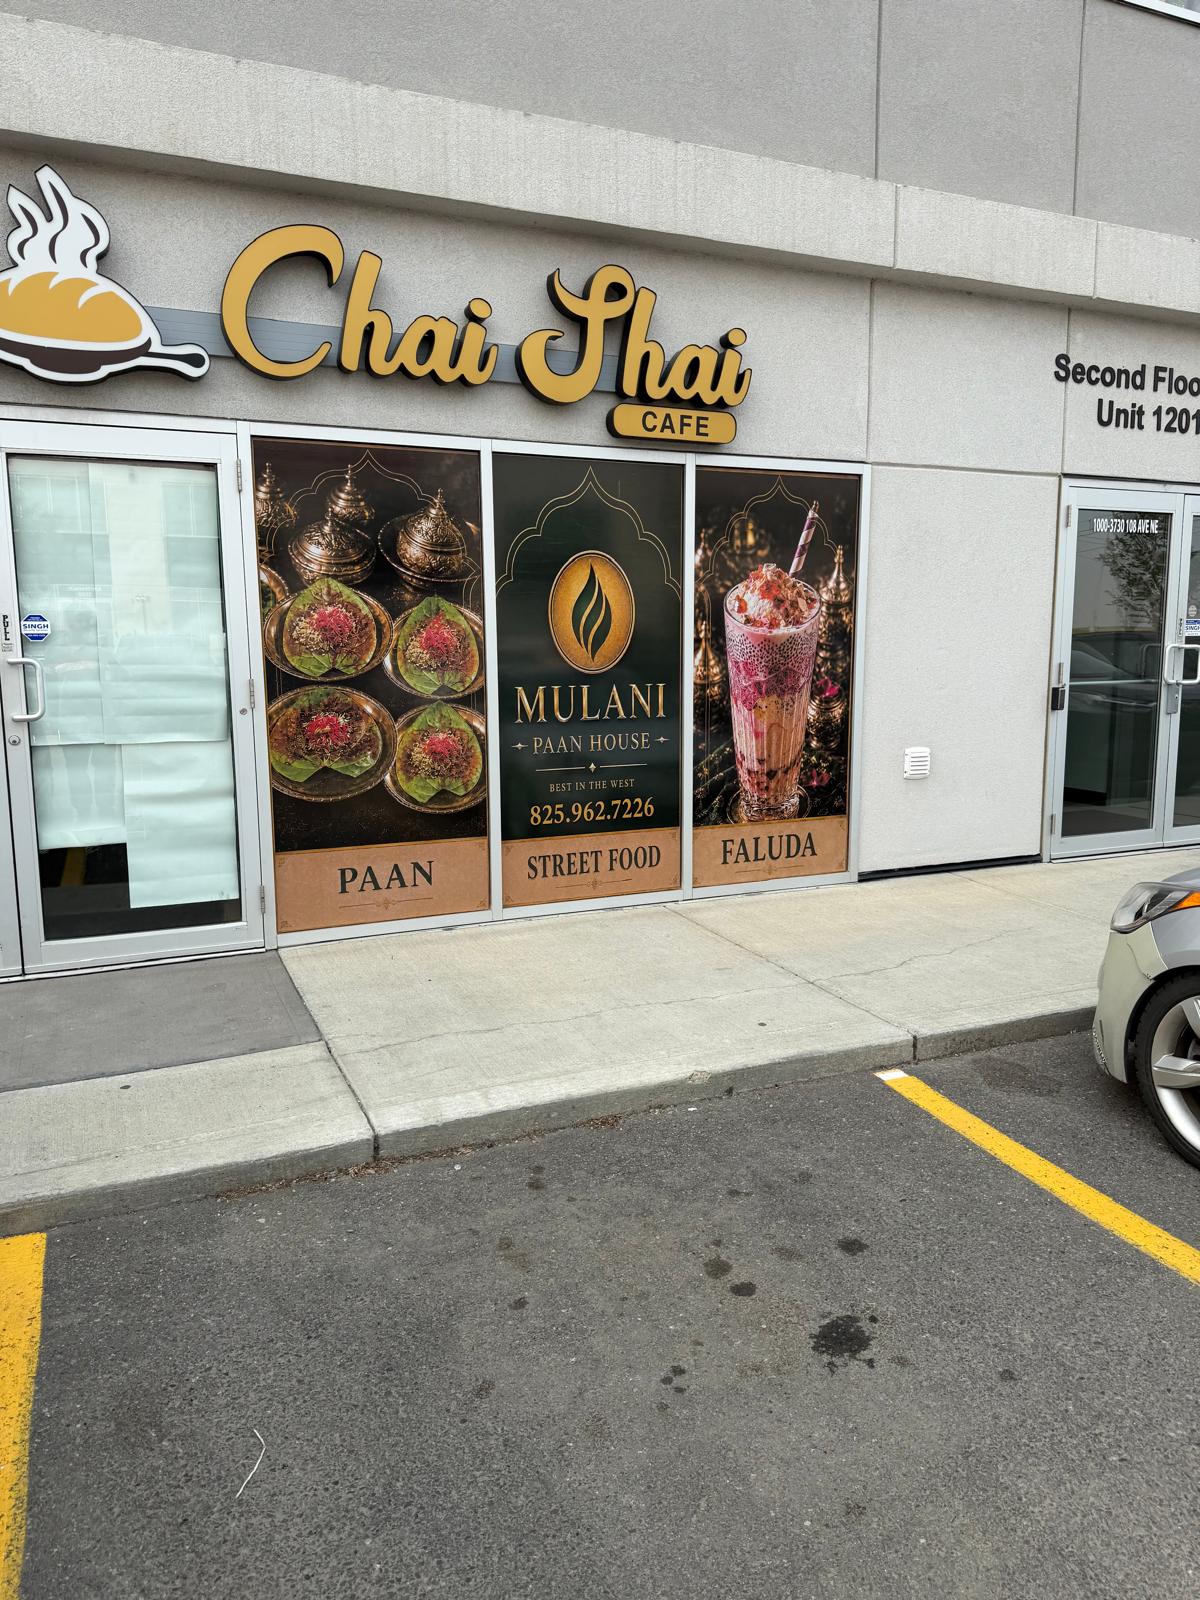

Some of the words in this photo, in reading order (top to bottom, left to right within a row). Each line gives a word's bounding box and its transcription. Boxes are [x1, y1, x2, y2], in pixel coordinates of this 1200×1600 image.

[220, 223, 499, 387] Chai
[1053, 353, 1147, 391] Second
[641, 411, 710, 437] CAFE
[1096, 398, 1145, 431] Unit
[1152, 405, 1200, 435] 1201
[1093, 518, 1125, 533] 1000-3730
[1137, 519, 1149, 534] AVE
[1149, 519, 1159, 534] NE
[2, 614, 11, 641] PULL
[514, 683, 667, 724] MULANI
[532, 735, 583, 755] PAAN
[589, 732, 650, 752] HOUSE
[549, 783, 572, 793] BEST
[575, 781, 586, 791] IN
[588, 780, 608, 790] THE
[610, 778, 636, 788] WEST
[529, 797, 655, 826] 825.962.7226
[527, 850, 603, 880] STREET
[608, 845, 661, 872] FOOD
[721, 832, 818, 865] FALUDA
[338, 860, 434, 894] PAAN
